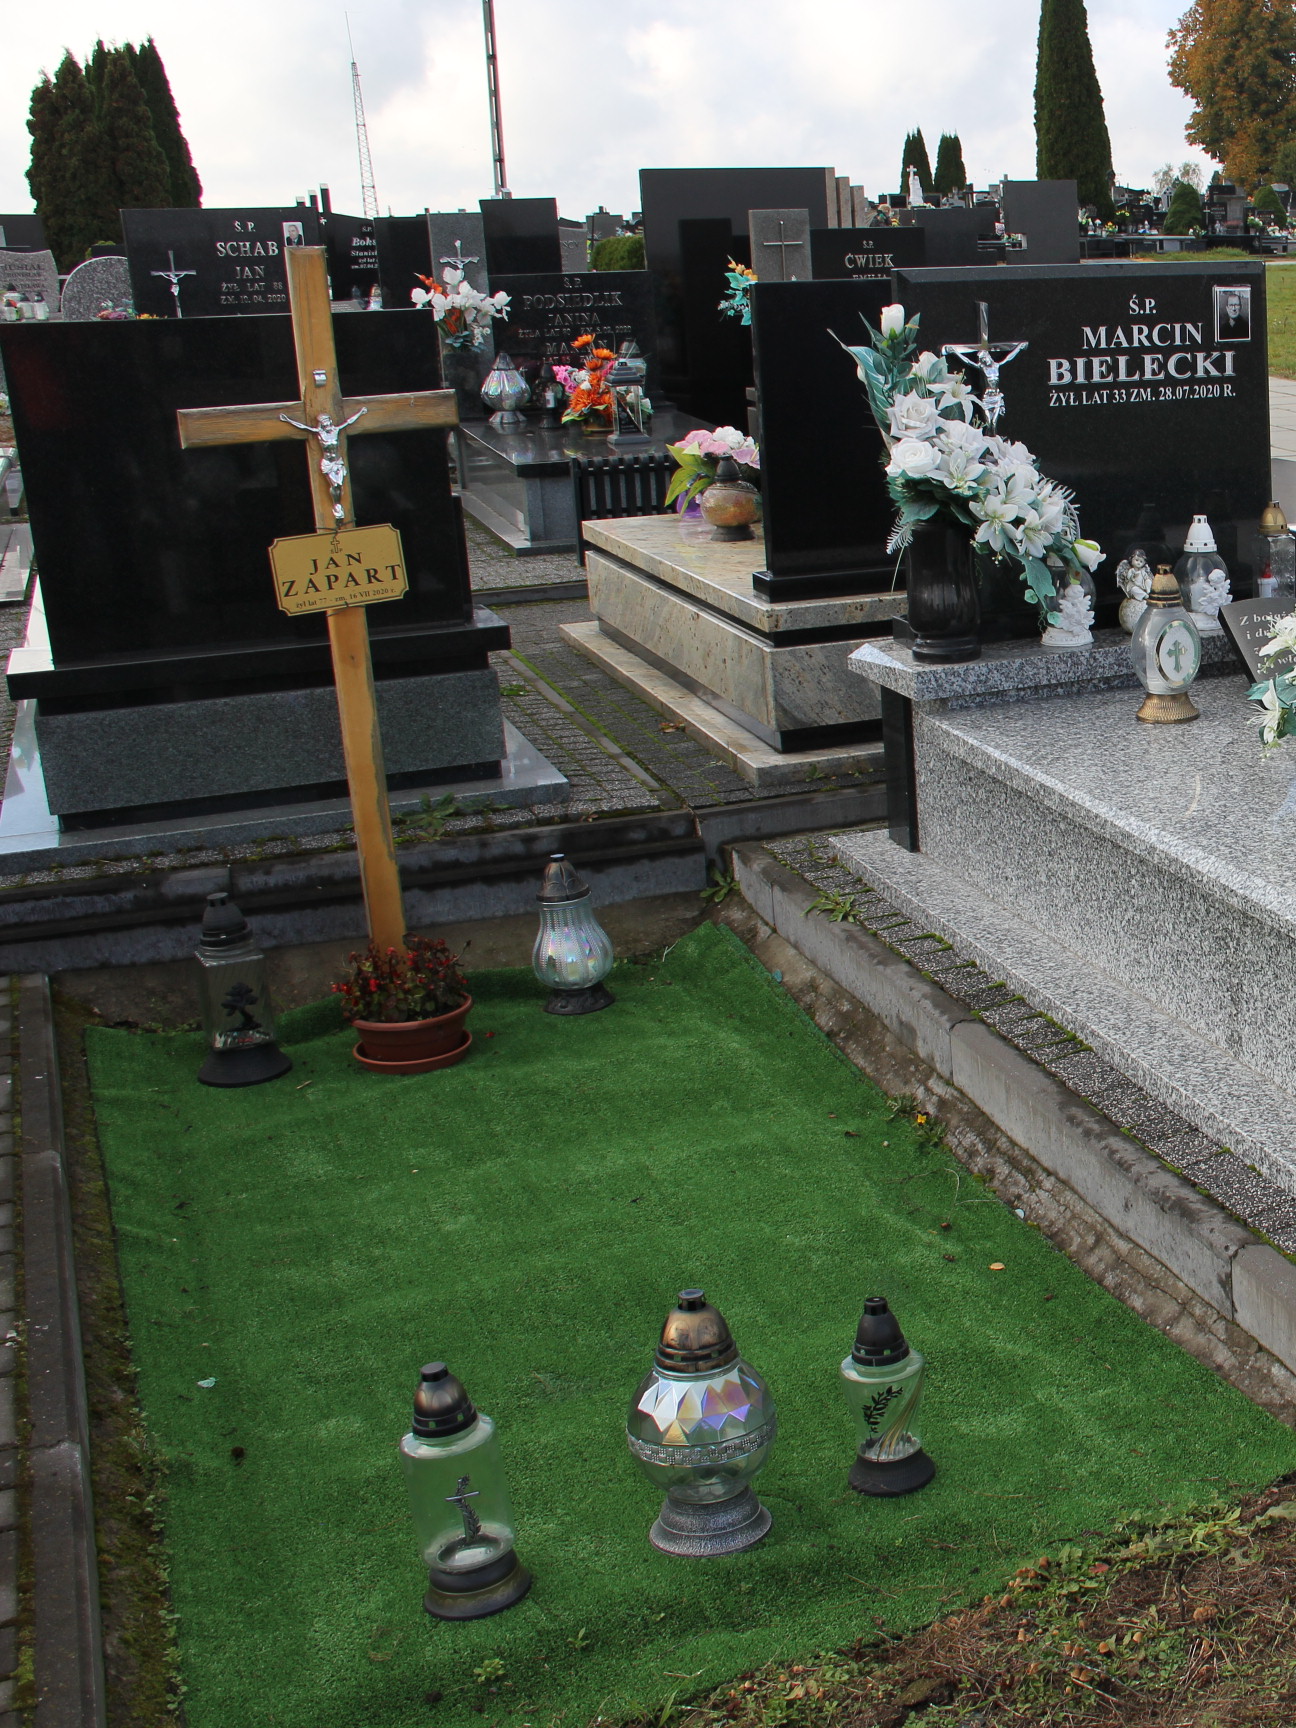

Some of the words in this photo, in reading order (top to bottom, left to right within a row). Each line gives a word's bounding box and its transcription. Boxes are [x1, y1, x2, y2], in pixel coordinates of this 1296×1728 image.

[216, 241, 279, 257] SCHAB
[844, 252, 895, 269] ĆWIEK
[235, 266, 266, 279] JAN
[246, 282, 266, 292] LAT
[522, 292, 624, 310] PODSIEDLIK
[1128, 294, 1157, 316] Ś.P.
[548, 312, 601, 326] JANINA
[1081, 322, 1203, 350] MARCIN
[1047, 351, 1237, 386] BIELECKI
[1050, 390, 1079, 407] ŻYŁ
[1082, 389, 1109, 405] LAT
[1112, 388, 1127, 404] 33
[1130, 387, 1155, 403] ZM.
[1158, 385, 1221, 402] 28.07.2020
[1223, 383, 1237, 398] R.
[309, 552, 363, 576] JAN
[281, 564, 402, 598] ZAPART
[359, 591, 371, 599] VII
[372, 588, 389, 597] 2020
[1239, 615, 1250, 626] Z
